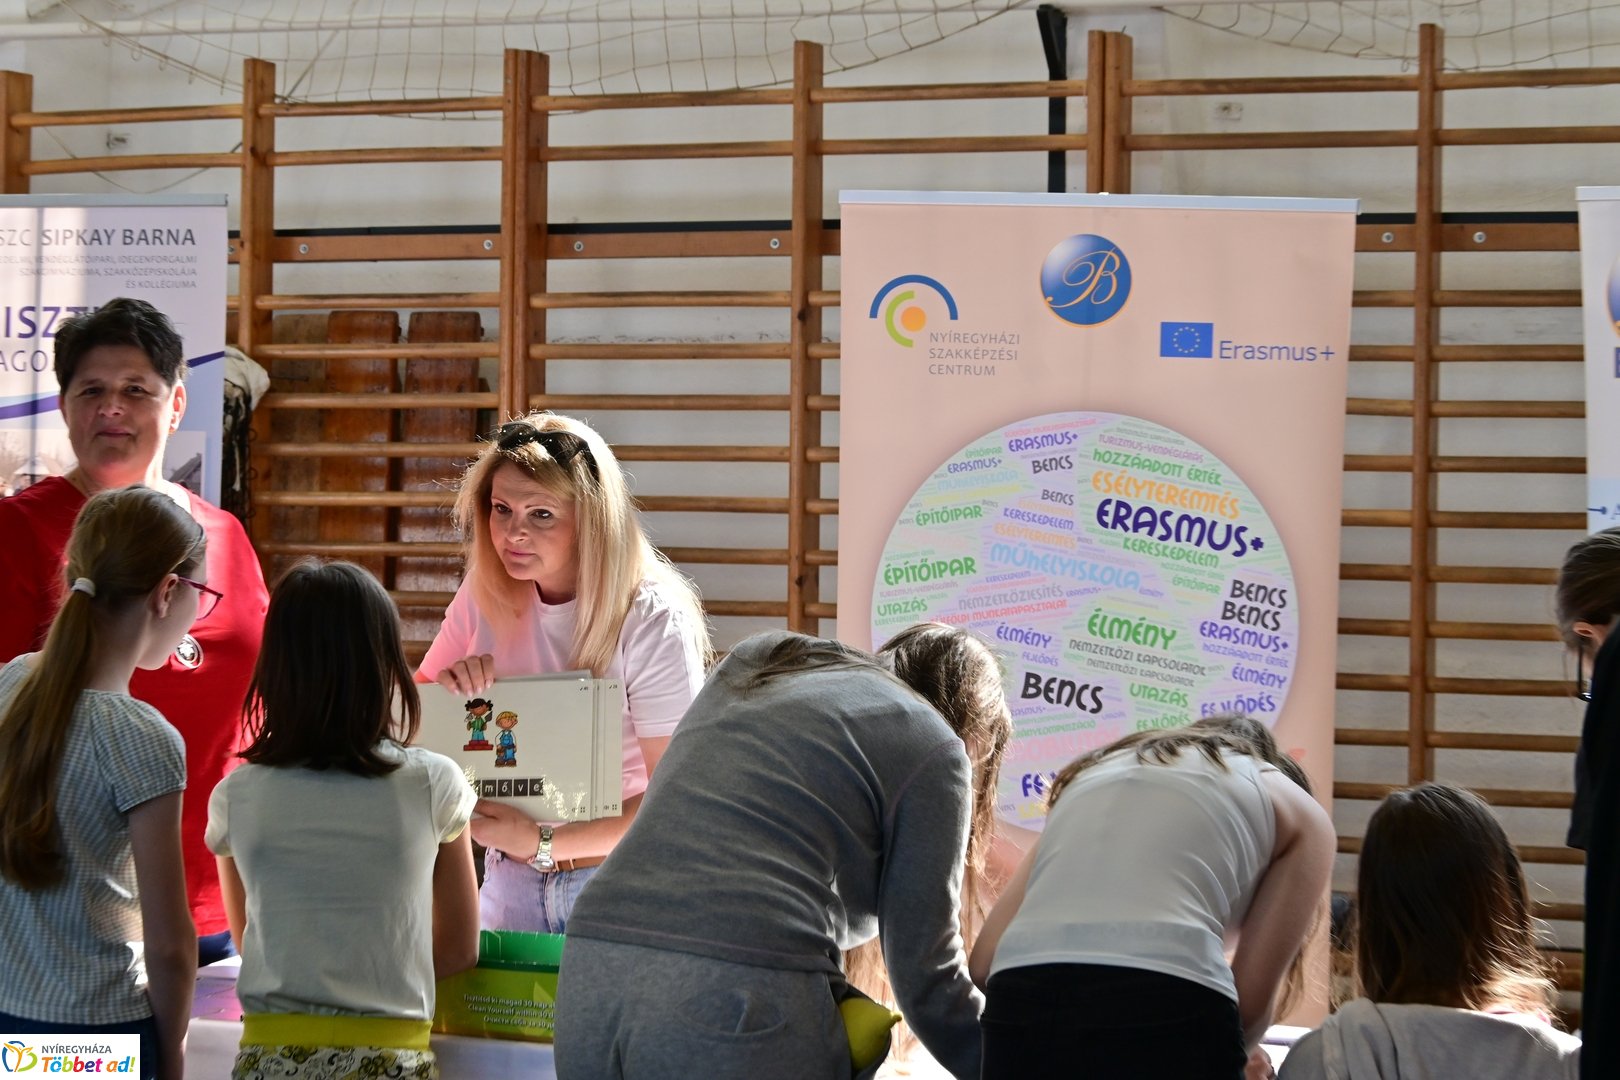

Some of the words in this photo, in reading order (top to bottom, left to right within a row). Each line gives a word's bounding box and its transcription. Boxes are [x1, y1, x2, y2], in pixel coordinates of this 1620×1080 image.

[41, 229, 115, 246] SIPKAY
[122, 229, 196, 246] BARNA
[929, 330, 1020, 345] NYÍREGYHÁZI
[928, 346, 1018, 361] SZAKKÉPZÉSI
[1219, 340, 1335, 361] Erasmus+
[928, 363, 996, 376] CENTRUM
[1008, 431, 1078, 452] ERASMUS+
[947, 457, 1002, 474] ERASMUS+
[1032, 455, 1073, 475] BENCS
[1186, 464, 1223, 486] ÉRTÉK
[1041, 489, 1074, 506] BENCS
[1091, 468, 1241, 520] ESÉLYTEREMTÉS
[915, 506, 983, 527] ÉPÍTŐIPAR
[1003, 507, 1074, 531] KERESKEDELEM
[1096, 498, 1265, 558] ERASMUS+
[1122, 537, 1220, 569] KERESKEDELEM
[883, 557, 977, 586] ÉPÍTŐIPAR
[877, 596, 928, 617] UTAZÁS
[1230, 579, 1287, 609] BENCS
[1087, 607, 1178, 650] ÉLMÉNY
[1220, 600, 1282, 632] BENCS
[996, 622, 1053, 649] ÉLMÉNY
[1199, 620, 1289, 653] ERASMUS+
[1069, 638, 1133, 661] NEMZETKÖZI
[1136, 653, 1207, 677] KAPCSOLATOK
[1232, 662, 1288, 689] ÉLMÉNY
[1020, 671, 1104, 714] BENCS
[1129, 682, 1189, 709] UTAZÁS
